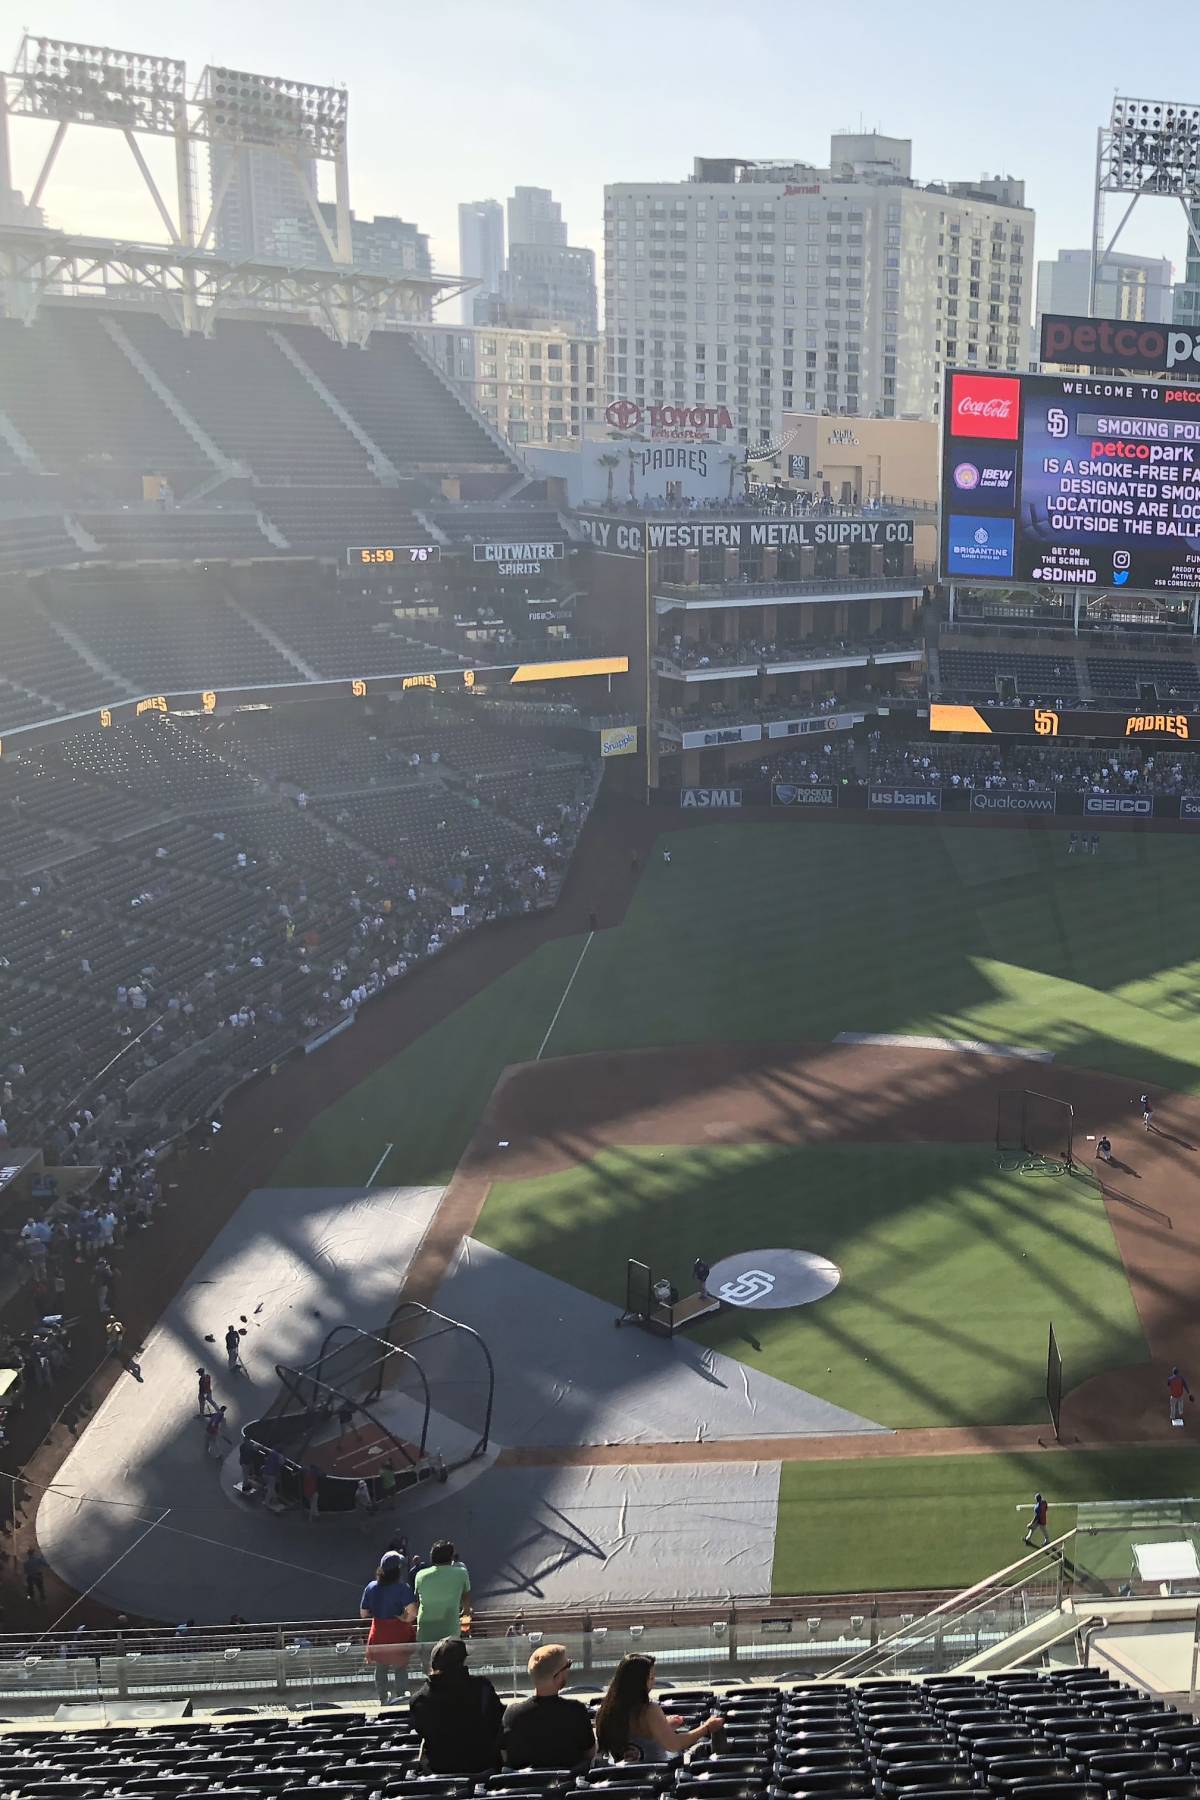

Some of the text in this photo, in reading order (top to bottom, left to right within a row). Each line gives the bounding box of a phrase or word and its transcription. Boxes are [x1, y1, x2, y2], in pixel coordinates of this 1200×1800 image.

[1063, 382, 1133, 397] WELCOME
[1141, 388, 1159, 400] TO
[646, 405, 733, 429] TOYOTA
[1097, 419, 1169, 438] SMOKING
[1090, 440, 1194, 464] petcopark
[641, 448, 707, 477] PADRES
[1043, 458, 1059, 473] IS
[1063, 460, 1075, 475] A
[1079, 461, 1178, 481] SMOKE-FREE
[980, 479, 996, 487] Local
[982, 469, 1013, 480] IBEW
[1060, 478, 1157, 498] DESIGNATED
[1047, 496, 1134, 515] LOCATIONS
[1137, 502, 1168, 517] ARE
[1051, 515, 1119, 532] OUTSIDE
[1123, 519, 1152, 534] THE
[650, 523, 913, 547] WESTERN METAL SUPPLY CO.
[361, 550, 394, 563] 5:59
[485, 545, 555, 560] CUTWATER
[954, 546, 1008, 556] BRIGANTINE
[1051, 547, 1080, 556] GET ON
[498, 562, 541, 576] SPIRITS
[1041, 555, 1090, 566] THE SCREEN
[402, 674, 437, 690] PADRES
[1125, 715, 1189, 739] PADRES
[603, 734, 635, 753] Snapple
[682, 790, 742, 808] ASML
[798, 789, 833, 797] ROCKET
[798, 795, 833, 804] LEAGUE
[974, 794, 1053, 810] Qualcomm
[1087, 798, 1151, 813] GEICO
